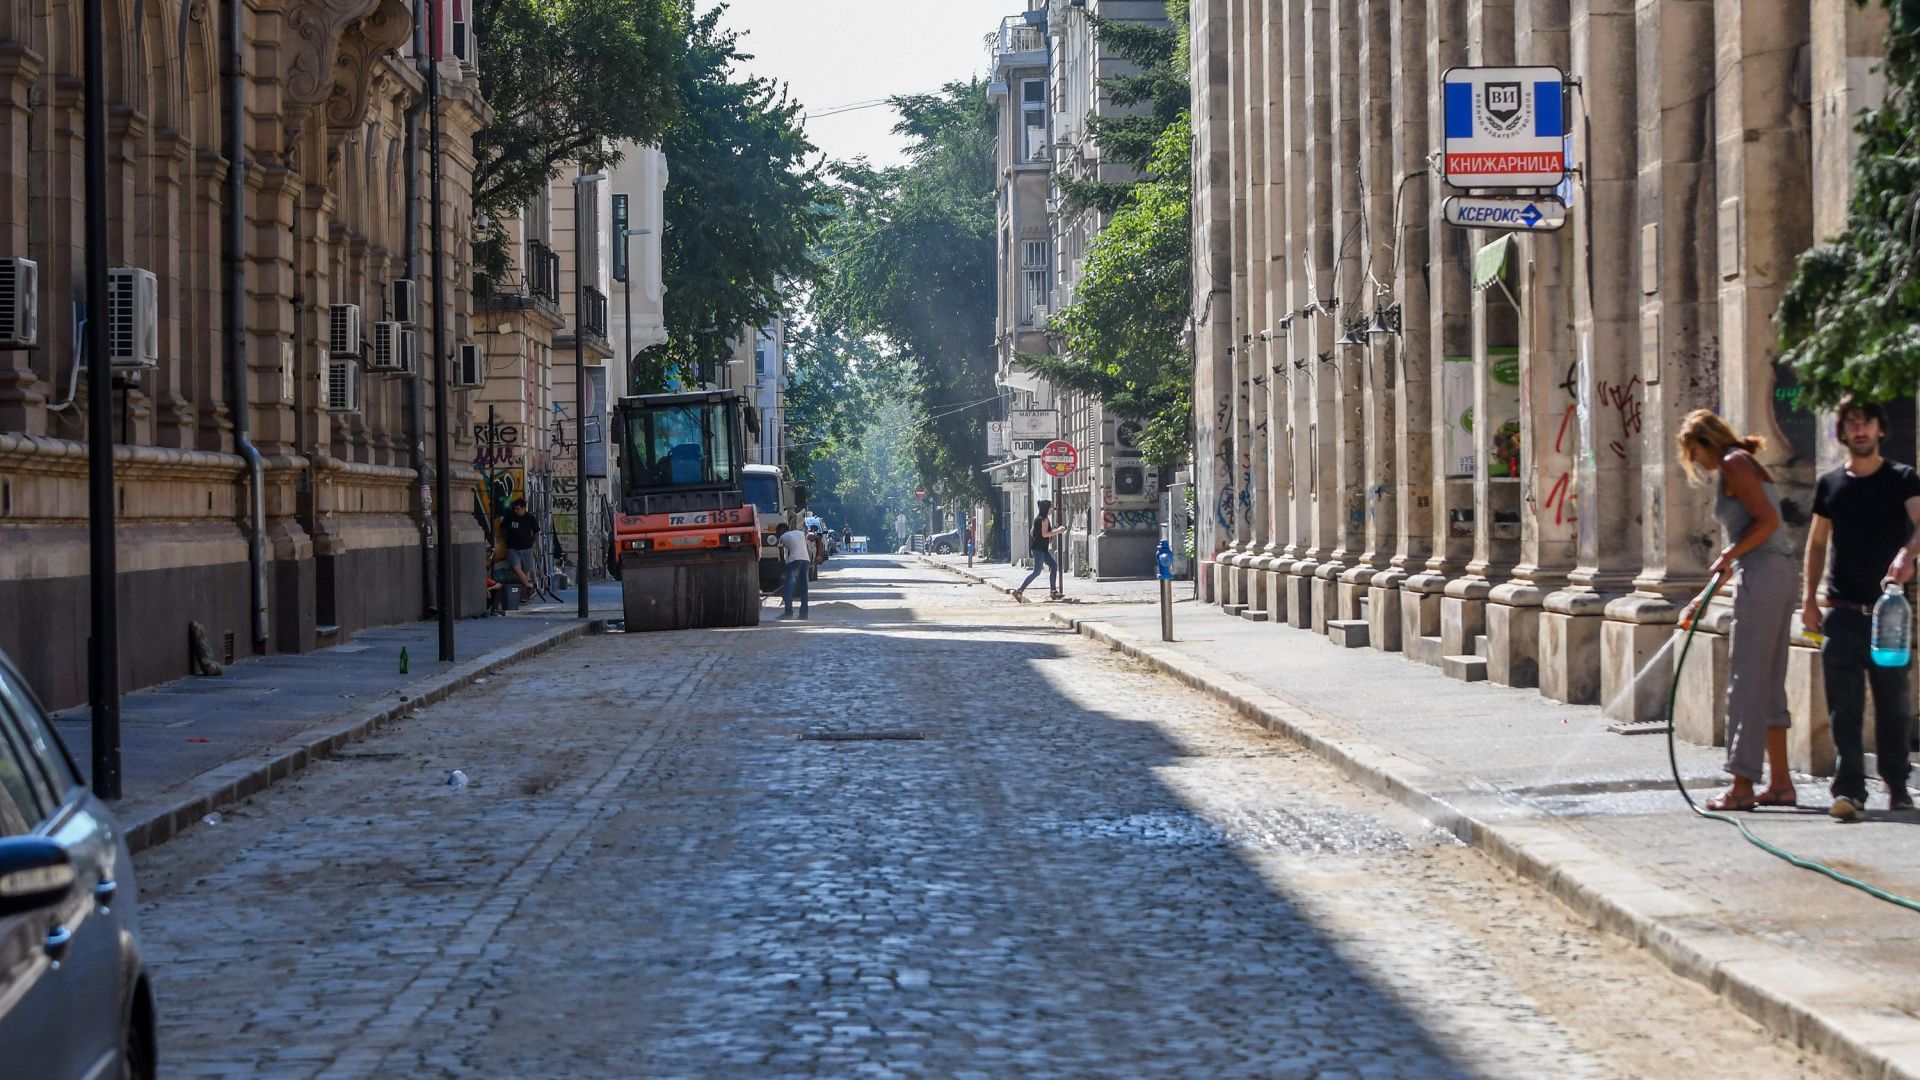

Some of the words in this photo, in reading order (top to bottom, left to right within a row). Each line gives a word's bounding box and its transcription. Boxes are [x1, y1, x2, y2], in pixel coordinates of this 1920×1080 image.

[1491, 90, 1515, 104] ВИ
[1450, 155, 1560, 172] КНИЖАРНИЦА
[1458, 206, 1520, 222] КСЕРОКС
[670, 514, 708, 526] TRCE
[709, 510, 740, 524] 185
